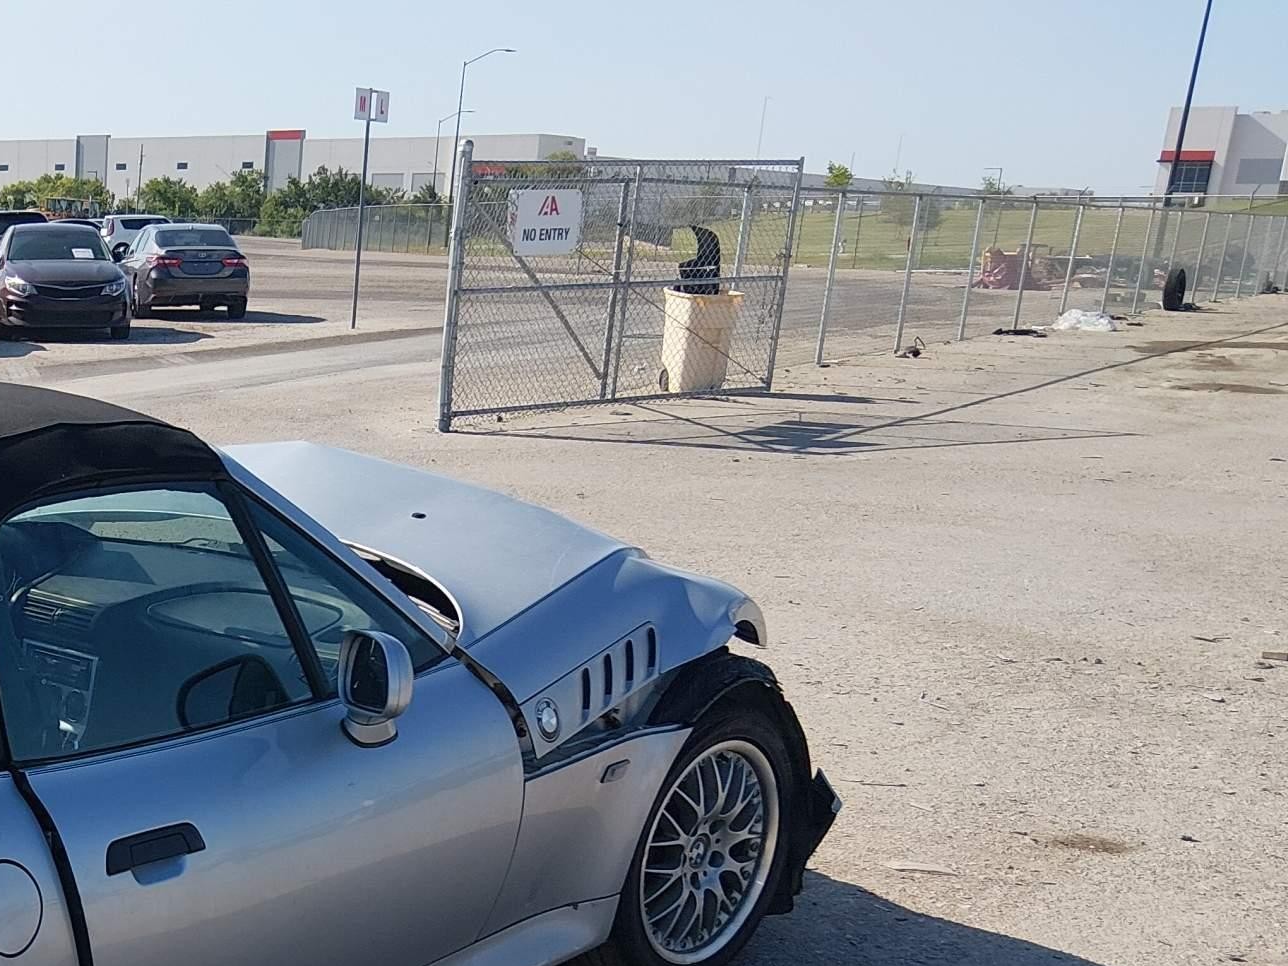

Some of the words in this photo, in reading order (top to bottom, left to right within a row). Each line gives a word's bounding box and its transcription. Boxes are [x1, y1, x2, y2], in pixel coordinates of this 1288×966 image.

[360, 95, 367, 113] M
[379, 98, 385, 115] L
[522, 228, 537, 242] NO
[539, 227, 570, 241] ENTRY
